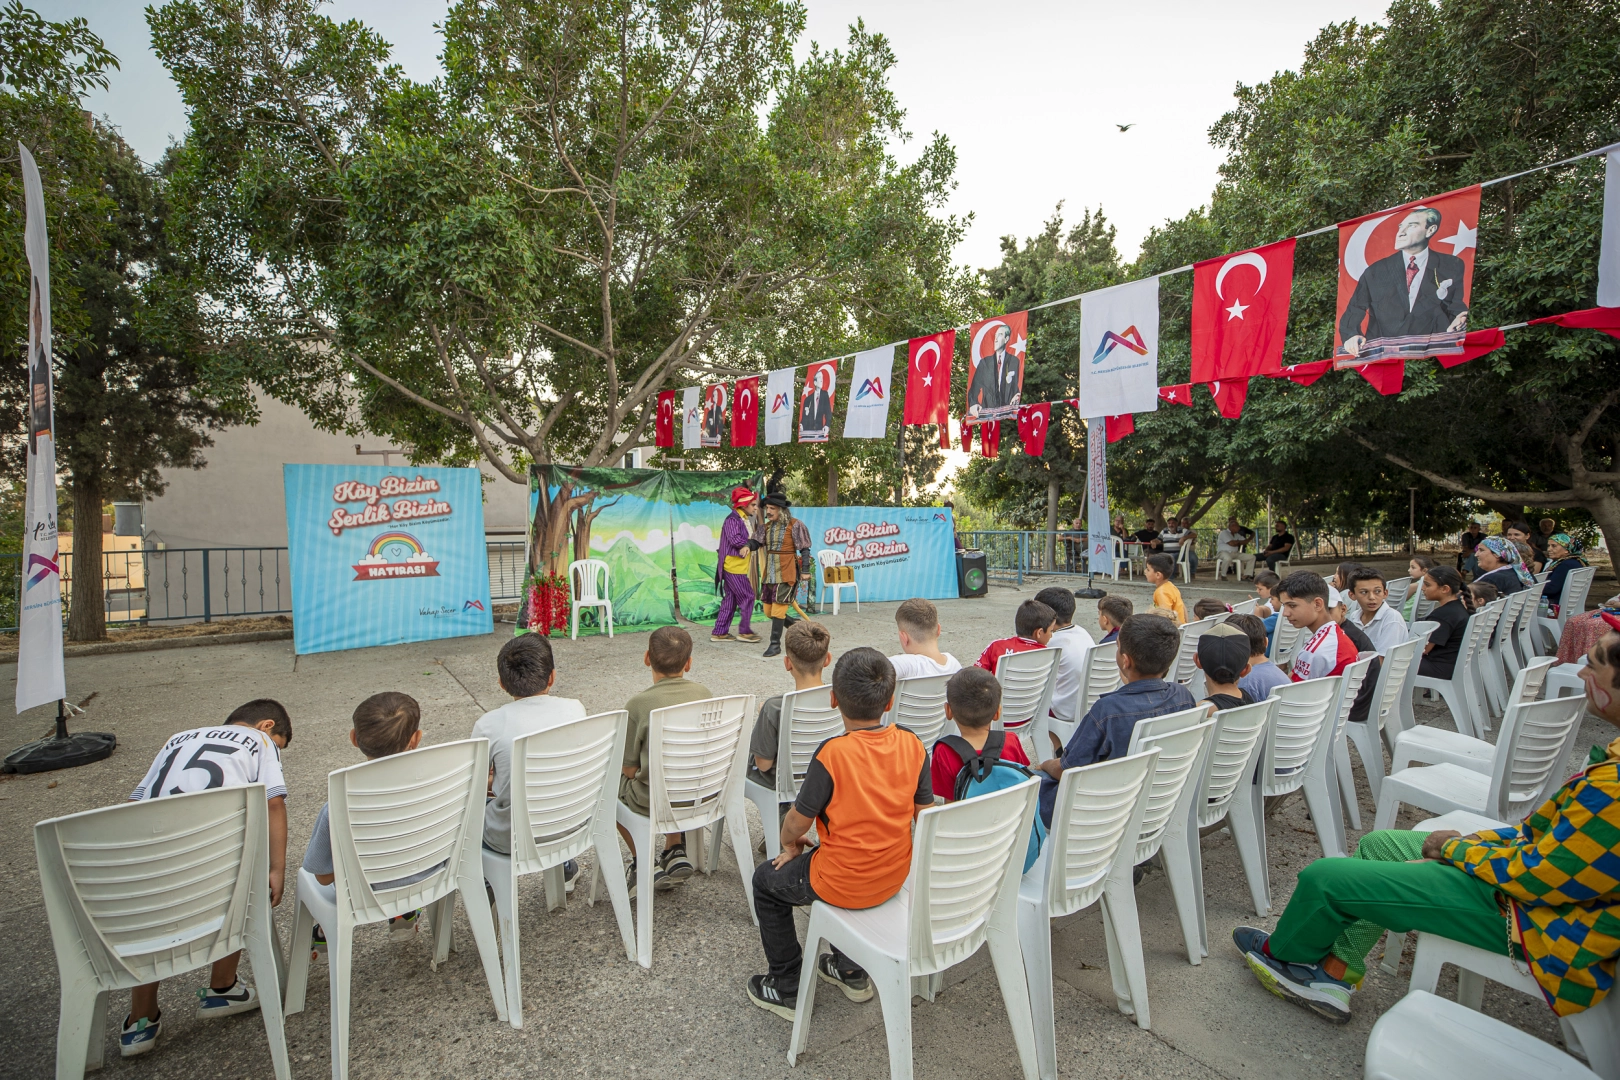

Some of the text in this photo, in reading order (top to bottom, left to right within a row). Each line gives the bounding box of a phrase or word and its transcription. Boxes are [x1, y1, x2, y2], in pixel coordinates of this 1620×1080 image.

[333, 475, 440, 505] Köy Bizim
[328, 498, 452, 536] Şenlik Bizim
[824, 521, 899, 546] Köy Bizim
[865, 540, 909, 560] Bizim
[368, 565, 426, 577] HATIRASI
[150, 743, 240, 799] 15
